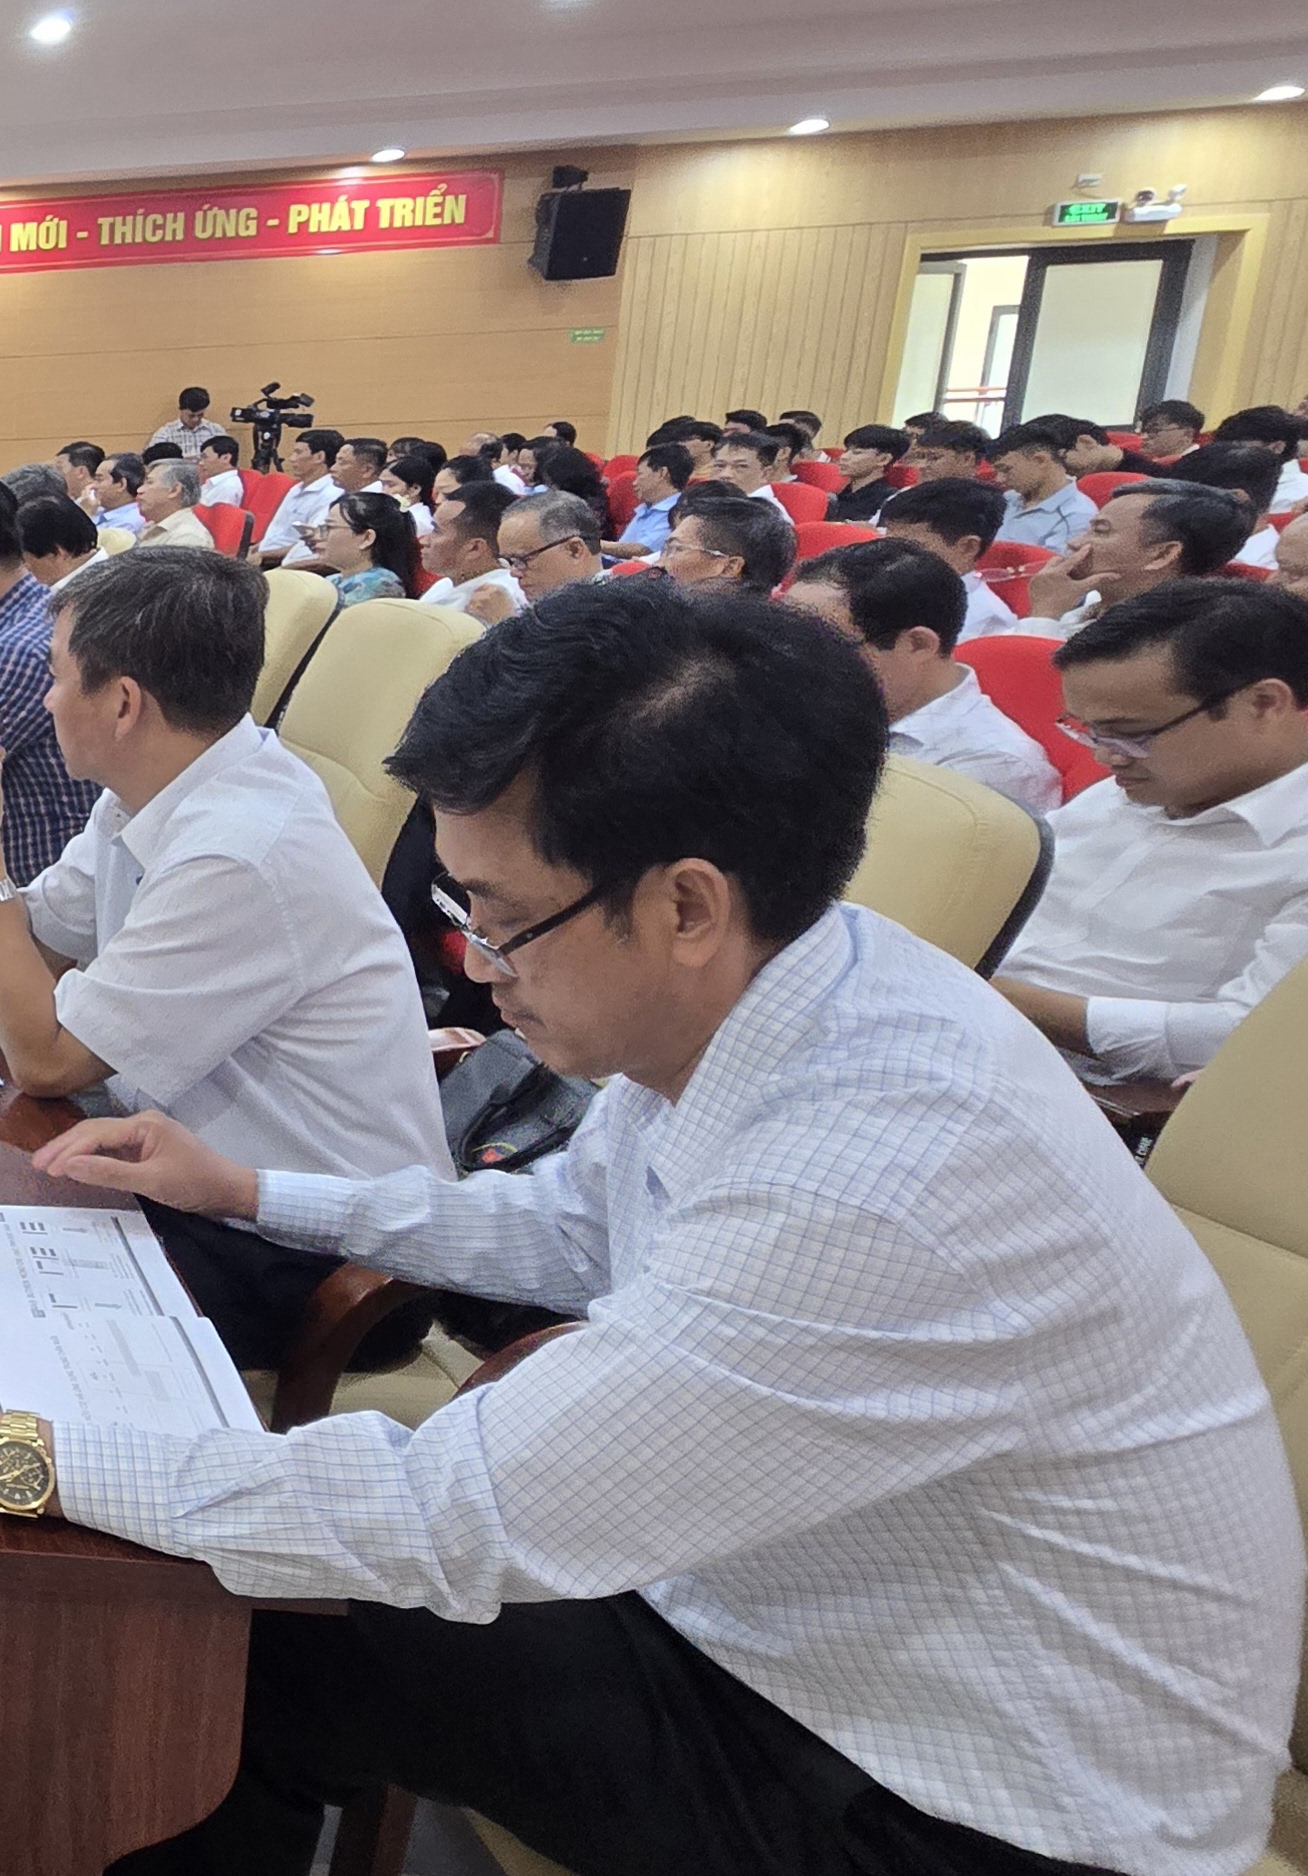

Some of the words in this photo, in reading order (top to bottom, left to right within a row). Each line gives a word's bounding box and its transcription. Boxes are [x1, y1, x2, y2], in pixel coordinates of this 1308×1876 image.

[10, 214, 68, 253] MỚI
[97, 209, 184, 246] THÍCH
[194, 204, 258, 240] ỨNG
[287, 194, 370, 234] PHÁT
[375, 183, 467, 229] TRIỂN
